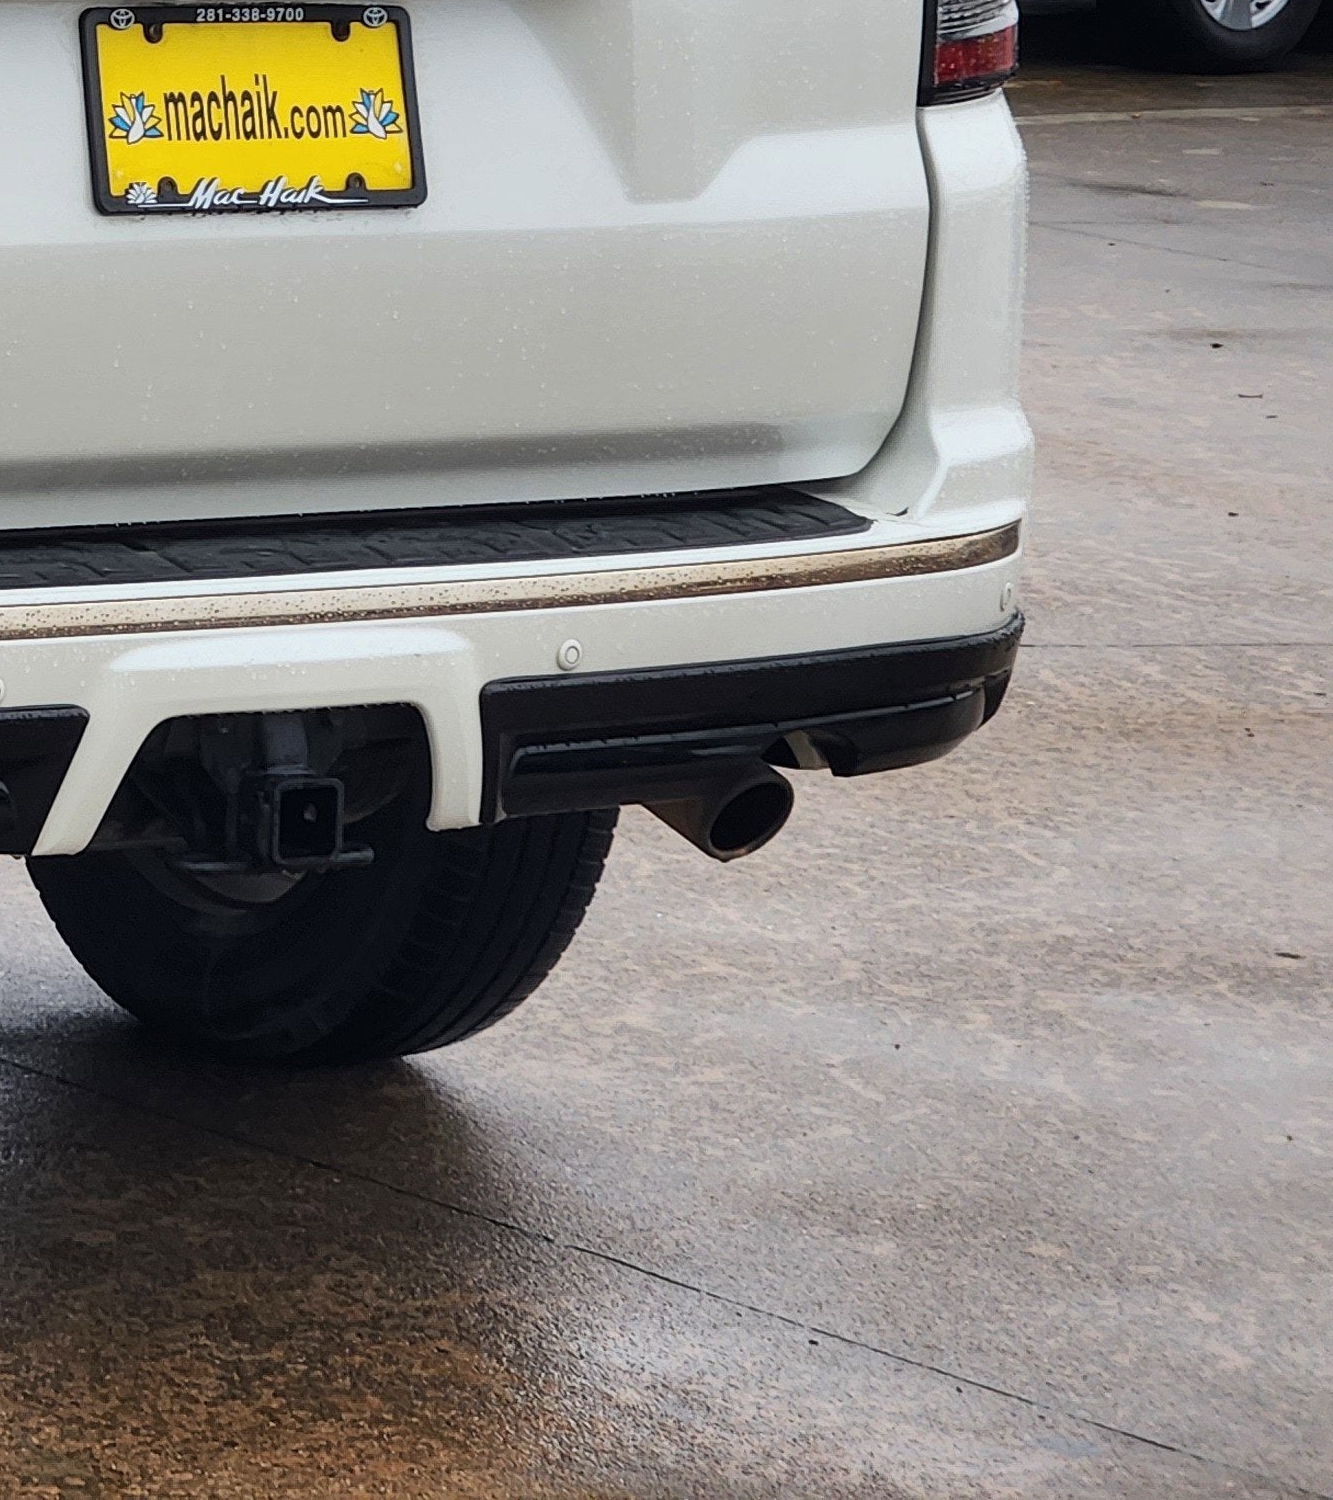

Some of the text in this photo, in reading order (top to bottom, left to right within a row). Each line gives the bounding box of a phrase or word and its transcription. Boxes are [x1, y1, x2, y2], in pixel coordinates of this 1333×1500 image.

[196, 8, 304, 22] 281-338-9700
[164, 74, 347, 142] machaik.com
[187, 176, 329, 209] Mac Haik
